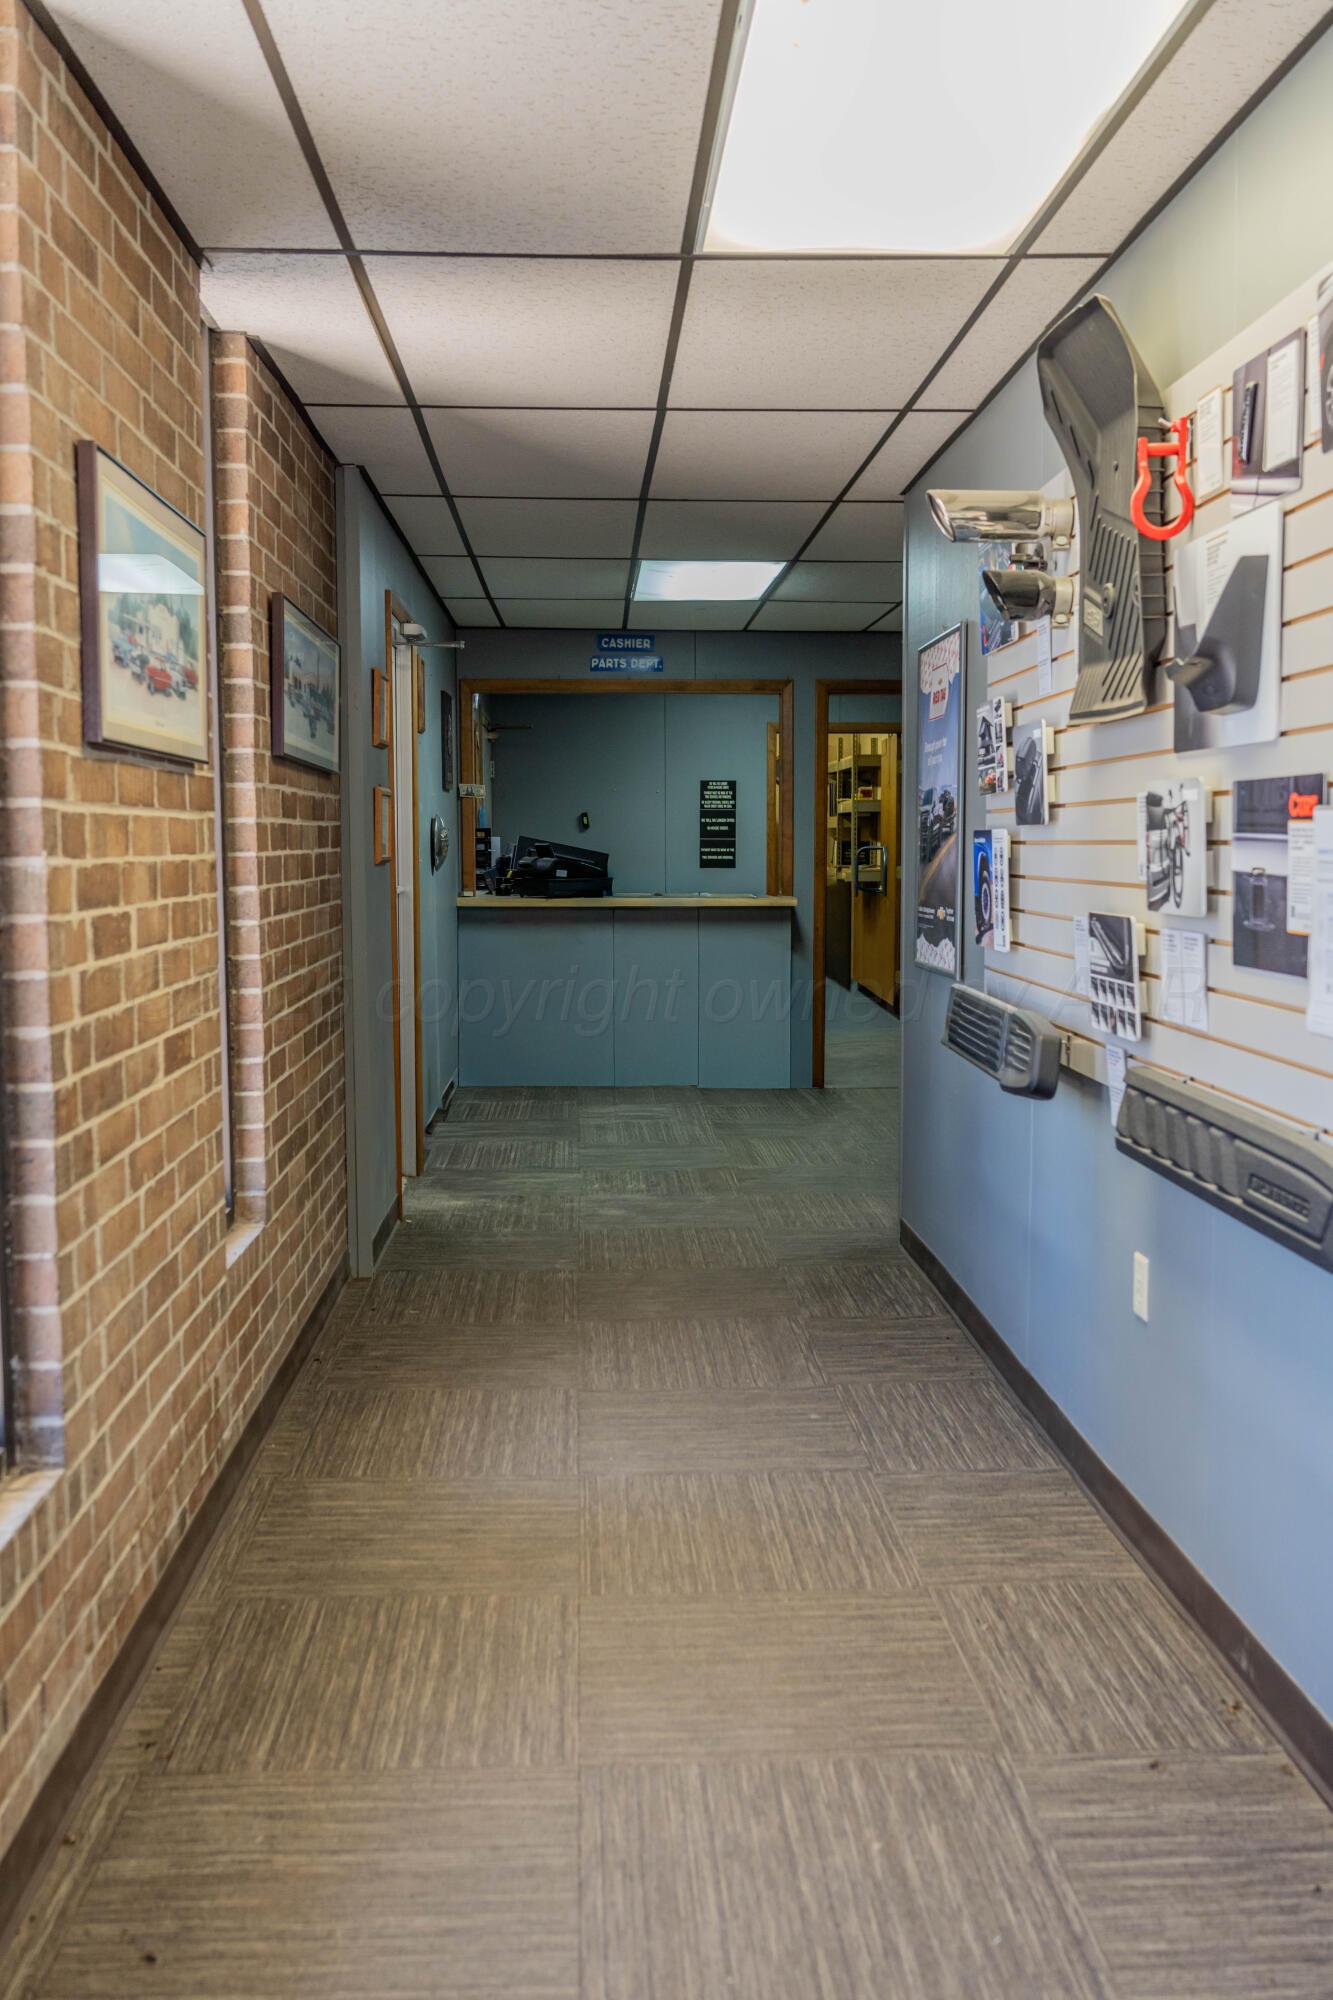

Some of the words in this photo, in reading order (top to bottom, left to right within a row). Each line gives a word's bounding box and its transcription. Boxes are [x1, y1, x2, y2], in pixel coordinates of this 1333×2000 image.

[601, 638, 651, 649] CASHIER
[591, 658, 627, 669] PARTS
[630, 658, 663, 669] DEPT.
